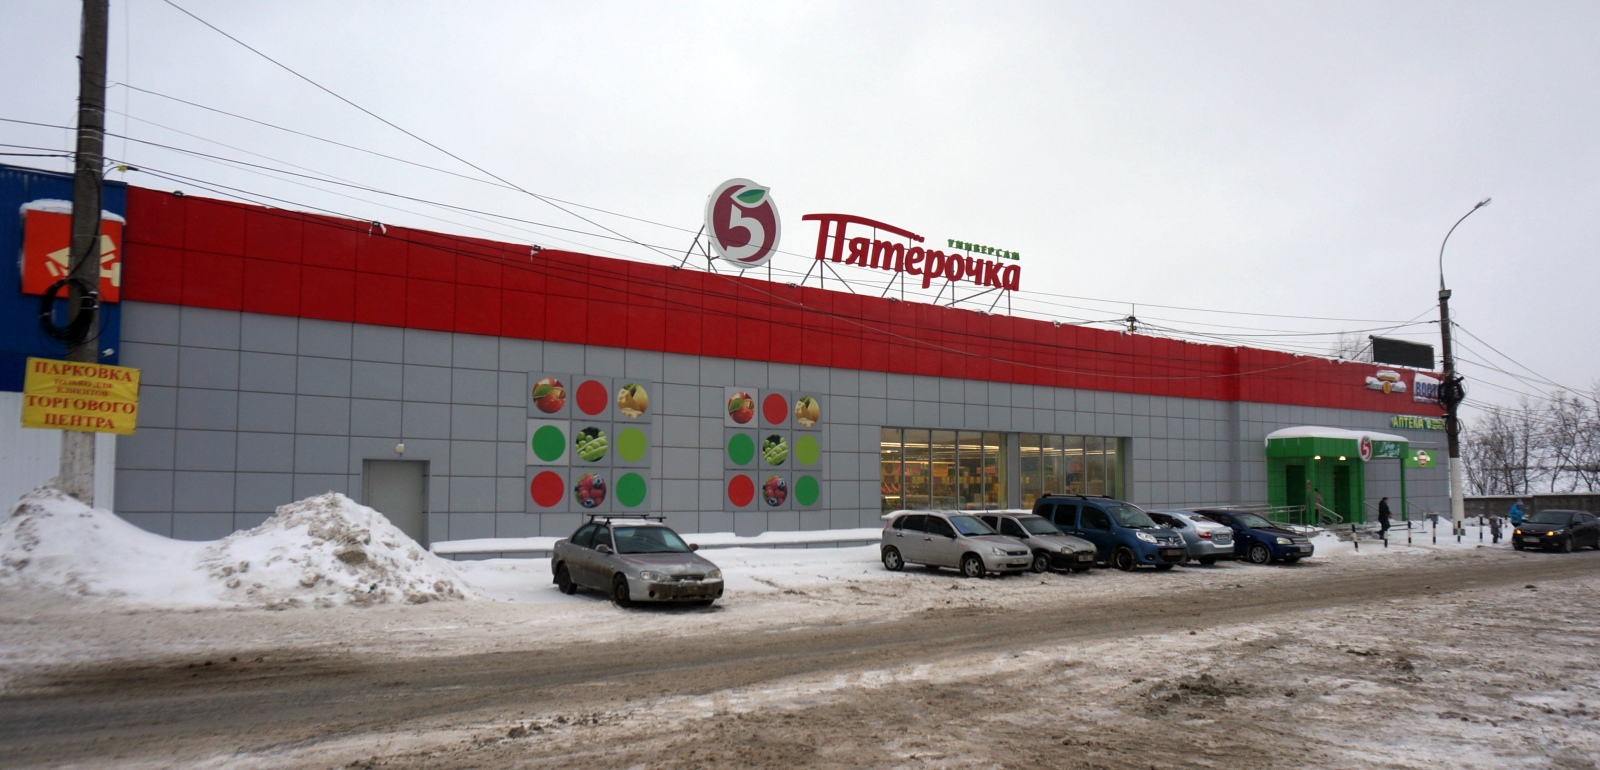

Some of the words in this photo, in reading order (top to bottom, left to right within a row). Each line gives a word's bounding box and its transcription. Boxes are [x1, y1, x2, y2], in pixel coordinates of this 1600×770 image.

[947, 239, 1020, 260] УНИВЕРСАМ
[34, 361, 133, 382] ПАРКОВКА
[56, 386, 110, 396] КЛИЕНТОВ
[27, 395, 136, 414] ТОРГОВОГО
[44, 413, 115, 429] ЦЕНТРА
[1393, 416, 1424, 429] АПТЕКА
